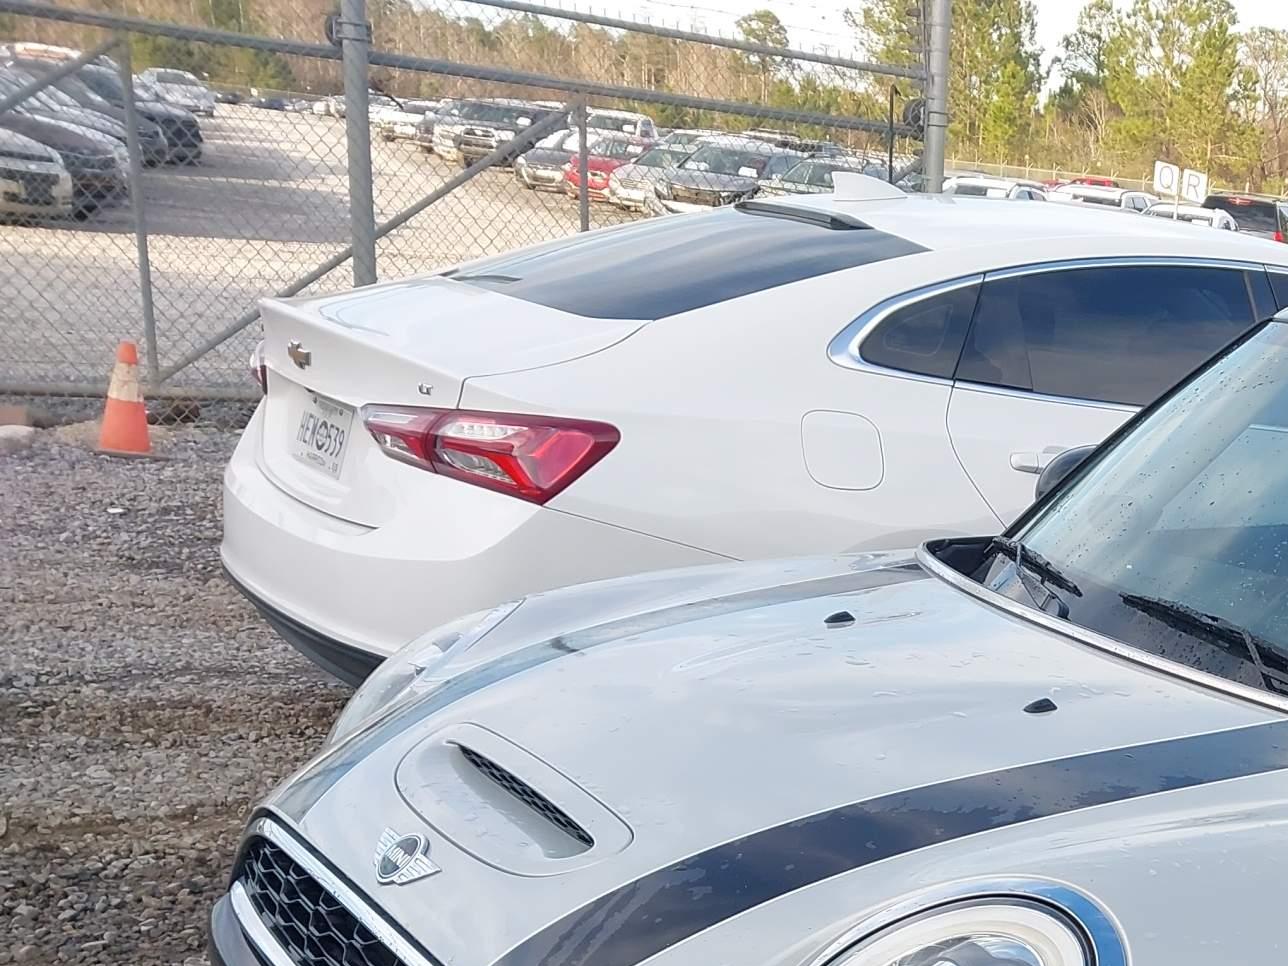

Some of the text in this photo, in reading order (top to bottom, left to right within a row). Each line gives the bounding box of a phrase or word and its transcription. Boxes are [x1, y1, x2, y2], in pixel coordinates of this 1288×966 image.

[1159, 165, 1174, 192] Q
[1186, 173, 1201, 200] R
[324, 423, 345, 458] 539
[386, 846, 412, 868] MINI
